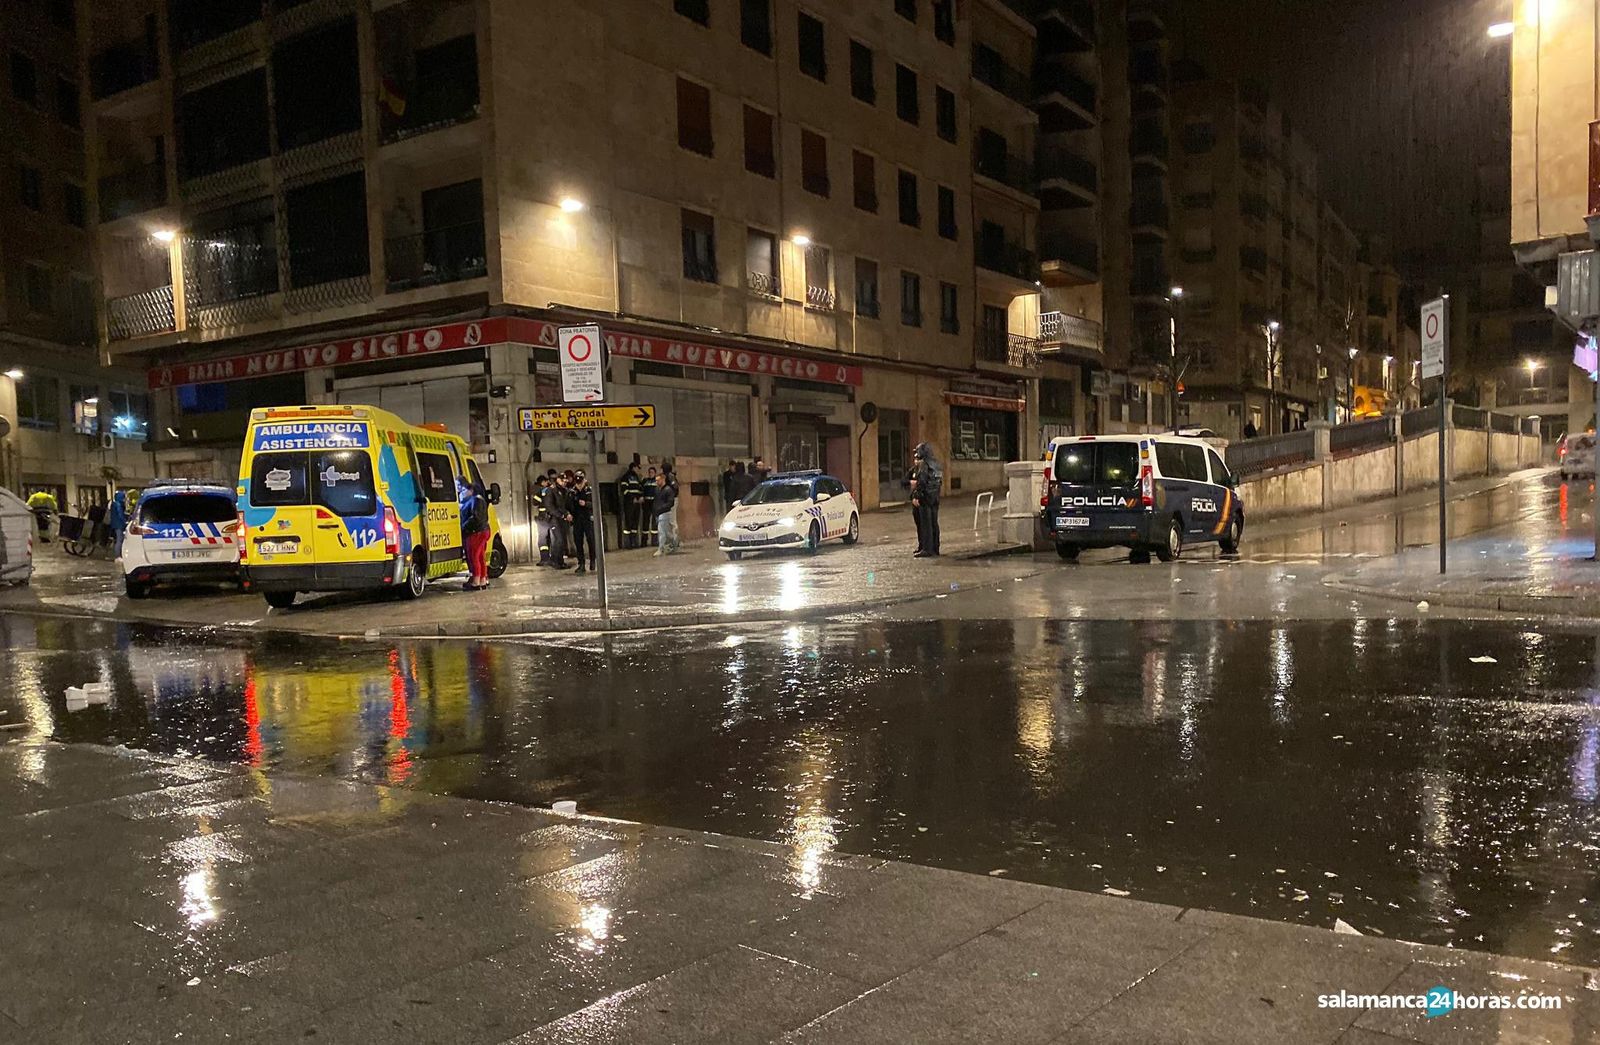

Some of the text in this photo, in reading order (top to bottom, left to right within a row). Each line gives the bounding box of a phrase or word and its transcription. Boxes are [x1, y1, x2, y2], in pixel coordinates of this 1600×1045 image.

[188, 329, 443, 382] BAZAR NUEVO SIGLO
[605, 334, 819, 377] AZAR NUEVO SIGLO
[568, 409, 605, 418] Condal
[535, 418, 609, 429] Santa Eulalia
[260, 423, 363, 436] AMBULANCIA
[260, 438, 363, 450] ASISTENCIAL
[1061, 495, 1128, 506] POLICÍA
[162, 528, 184, 537] 112
[350, 529, 377, 549] 112
[281, 544, 296, 552] HNK
